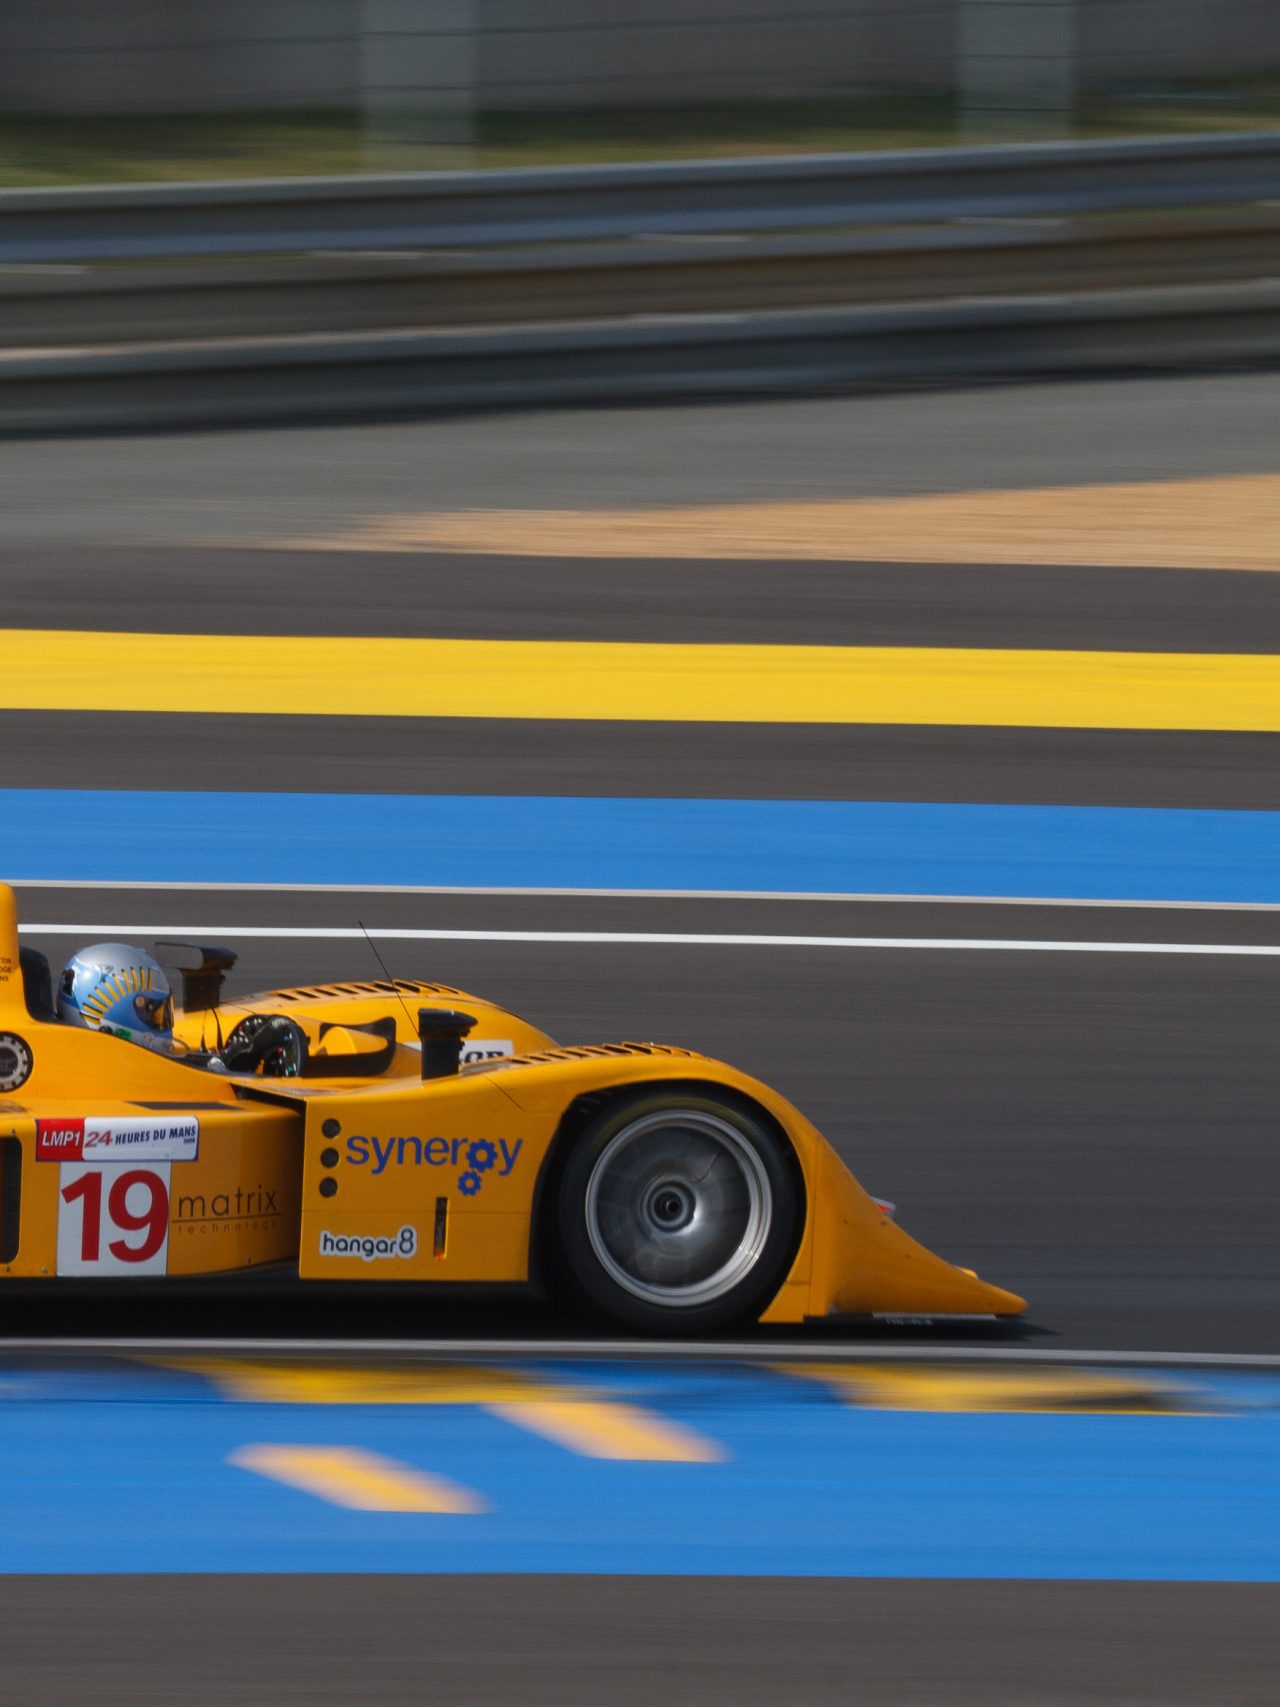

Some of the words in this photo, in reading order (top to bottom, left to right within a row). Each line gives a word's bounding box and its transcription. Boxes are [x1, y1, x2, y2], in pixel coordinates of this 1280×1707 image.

[42, 1131, 81, 1147] LMP1
[84, 1130, 113, 1149] 24
[115, 1131, 150, 1145] HEURES
[153, 1130, 166, 1140] DU
[169, 1125, 196, 1139] MANS
[346, 1135, 523, 1196] synergy
[61, 1169, 169, 1264] 19
[178, 1184, 277, 1218] matrix
[178, 1220, 277, 1235] technology
[323, 1228, 414, 1257] hangar8
